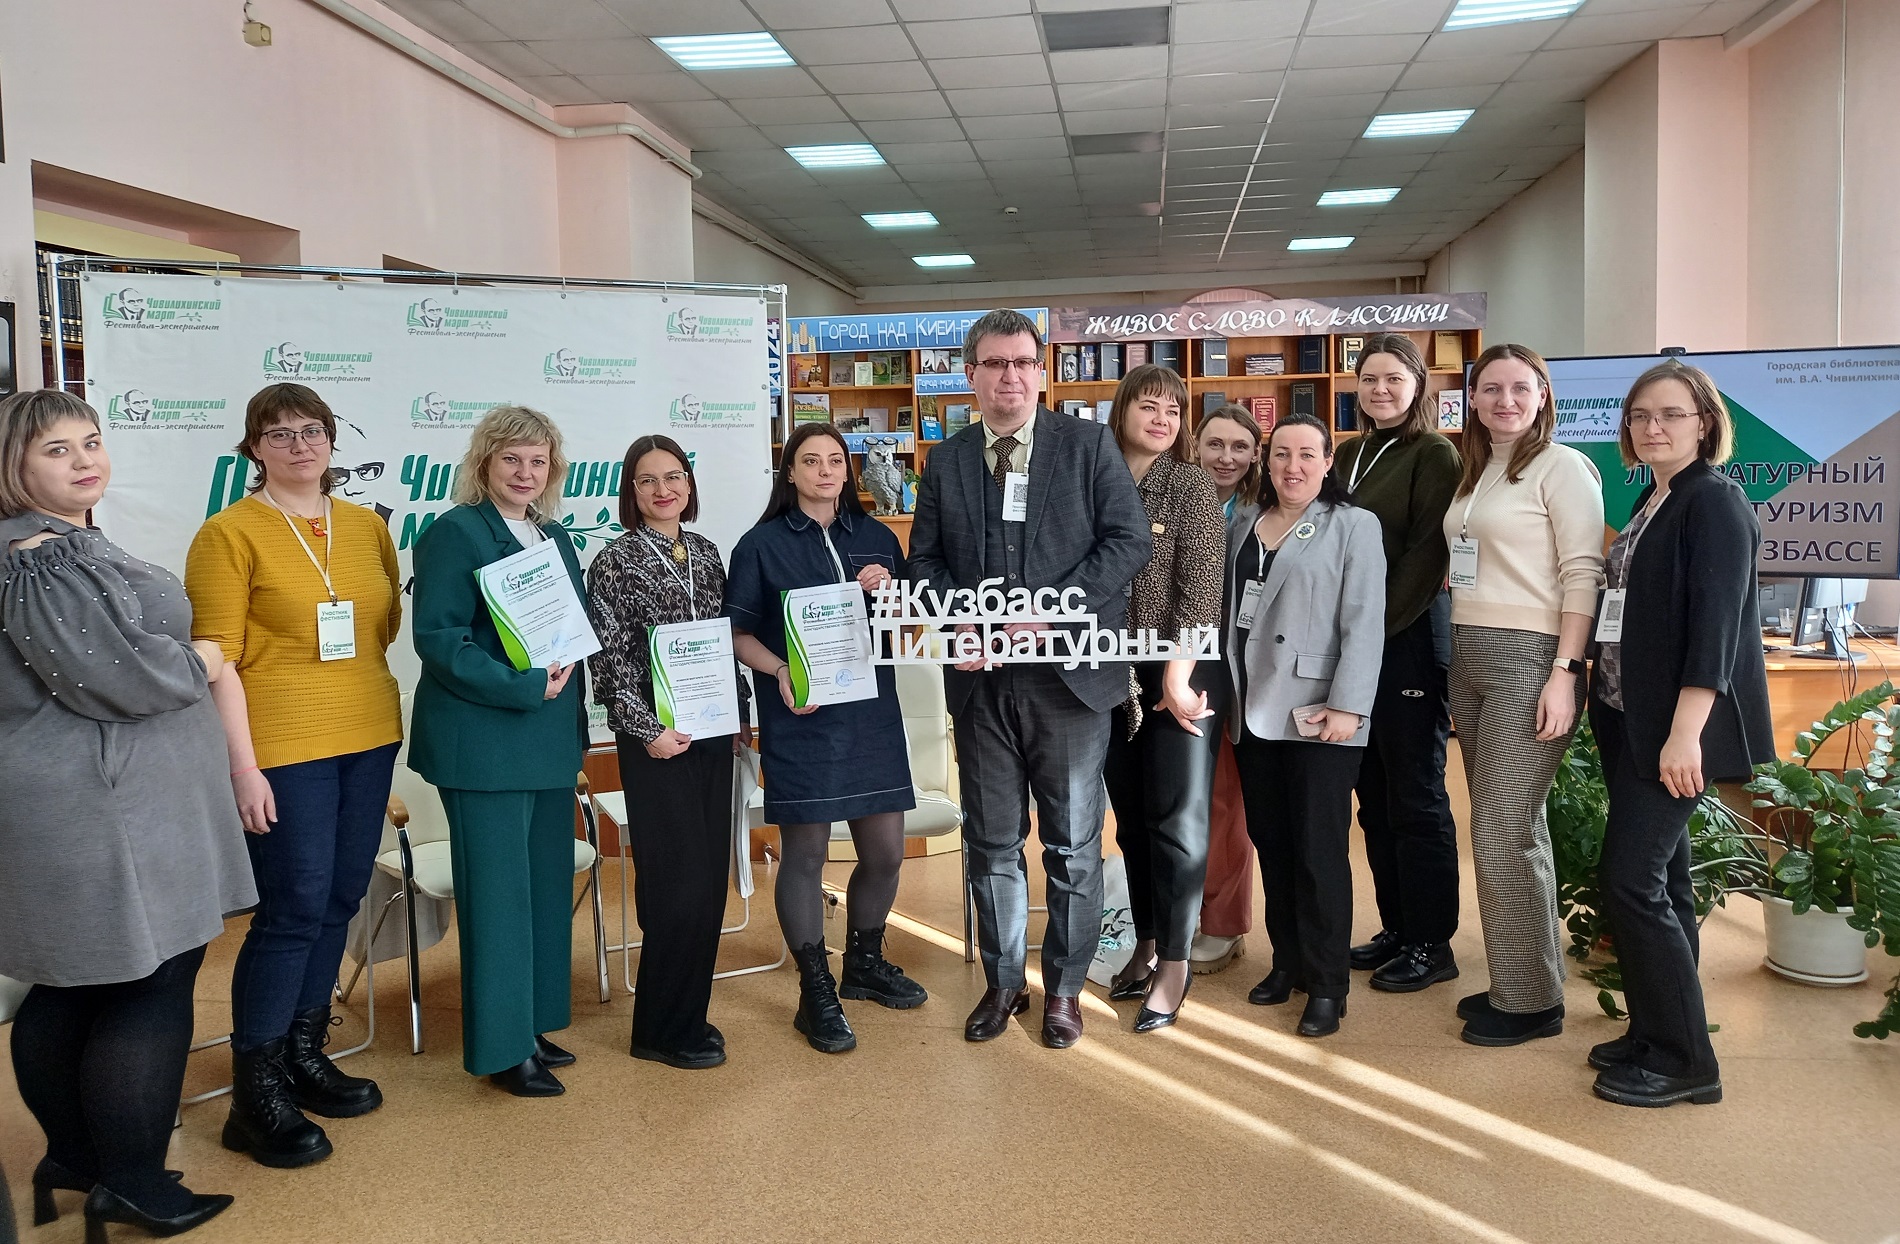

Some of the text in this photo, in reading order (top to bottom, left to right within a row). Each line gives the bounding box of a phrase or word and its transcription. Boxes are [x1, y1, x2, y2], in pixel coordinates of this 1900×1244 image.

[147, 297, 222, 310] Чивилихинский
[147, 310, 175, 322] март
[444, 307, 508, 319] Чивилихинский
[104, 320, 220, 331] Фестиваль-эксперимент
[444, 318, 469, 330] март
[699, 315, 754, 327] Чивилихинский
[1084, 303, 1449, 336] ЖИВОЕ СЛОВО КЛАССИКИ
[408, 328, 506, 339] Фестиваль-эксперимент
[699, 325, 721, 336] март
[304, 351, 373, 362] Чивилихинский
[578, 356, 637, 367] Чивилихинский
[304, 362, 330, 373] март
[578, 366, 601, 376] март
[1767, 358, 1900, 372] Городская библиотека
[264, 373, 371, 383] Фестиваль-эксперимент
[1776, 373, 1900, 384] им. В.А. Чивилихина
[152, 398, 226, 410] Чивилихинский
[701, 401, 756, 412] Чивилихинский
[152, 410, 180, 422] март
[448, 411, 473, 422] март
[701, 411, 723, 422] март
[109, 420, 225, 432] Фестиваль-эксперимент
[1751, 501, 1883, 524] ТУРИЗМ
[1762, 540, 1882, 562] ЗБАССЕ
[871, 577, 1087, 627] #Кузбасс
[868, 622, 1221, 671] Литературный
[589, 711, 607, 721] мар
